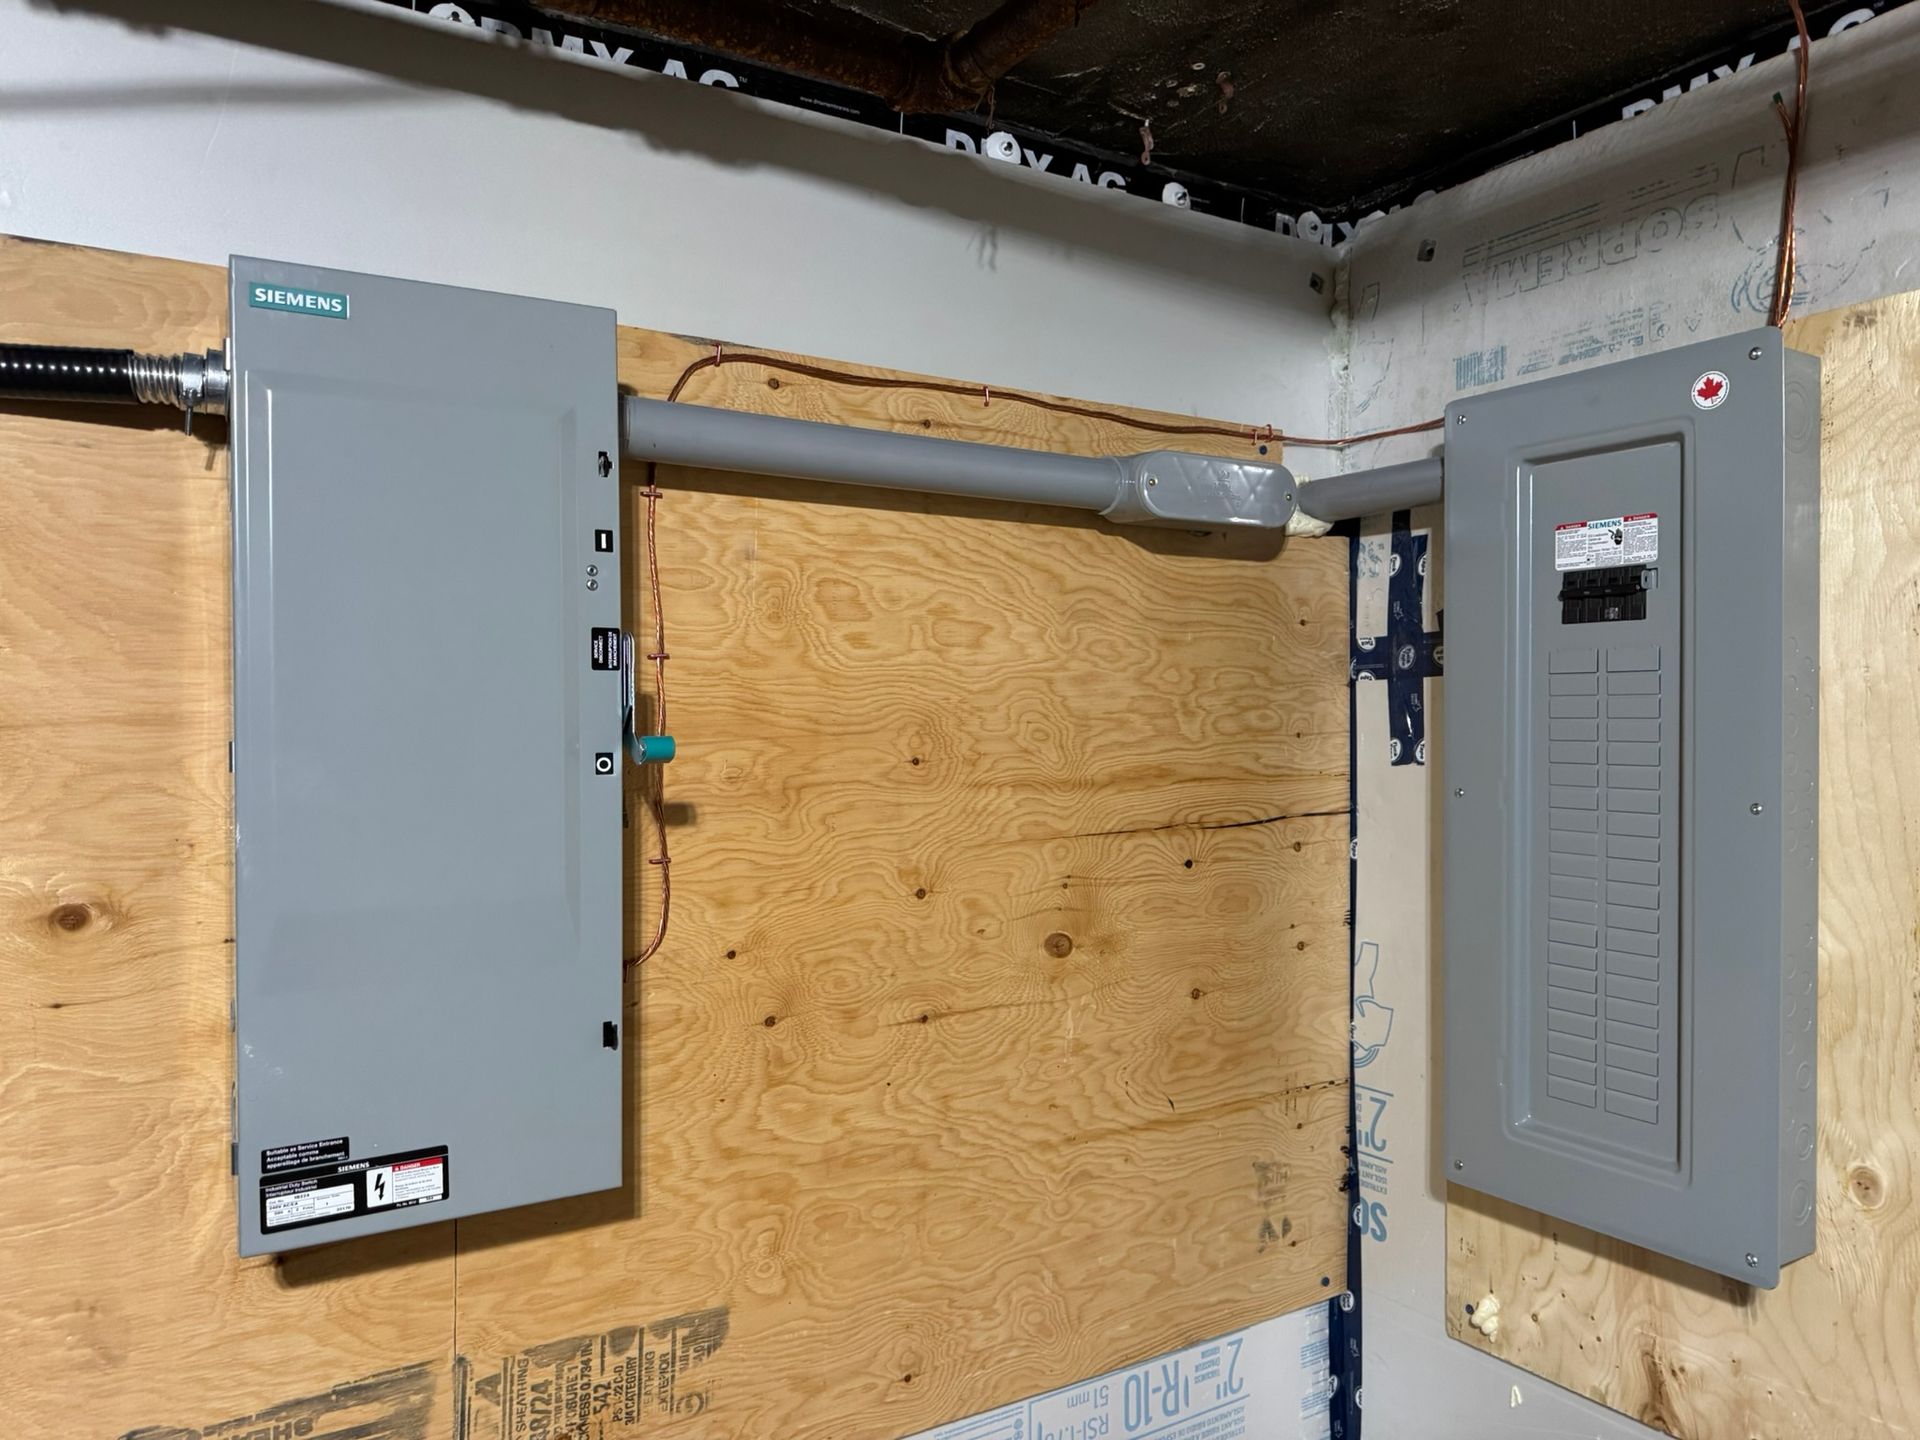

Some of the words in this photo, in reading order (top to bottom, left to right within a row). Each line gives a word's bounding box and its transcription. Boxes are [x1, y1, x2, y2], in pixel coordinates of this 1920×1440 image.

[254, 287, 343, 312] SIEMENS
[1588, 520, 1622, 529] SIEMENS
[266, 1147, 289, 1157] Suitable
[297, 1143, 318, 1151] Service
[319, 1139, 343, 1148] Entrance
[266, 1152, 298, 1163] Acceptable
[266, 1159, 300, 1169] appareillage
[309, 1151, 345, 1162] branchement
[337, 1161, 370, 1173] SIEMENS
[1216, 1337, 1244, 1400] 2"
[625, 1356, 638, 1409] CATEGORY
[516, 1357, 530, 1433] SHEATHING
[592, 1380, 612, 1415] 542
[1067, 1391, 1090, 1409] mm
[1094, 1385, 1109, 1409] 51
